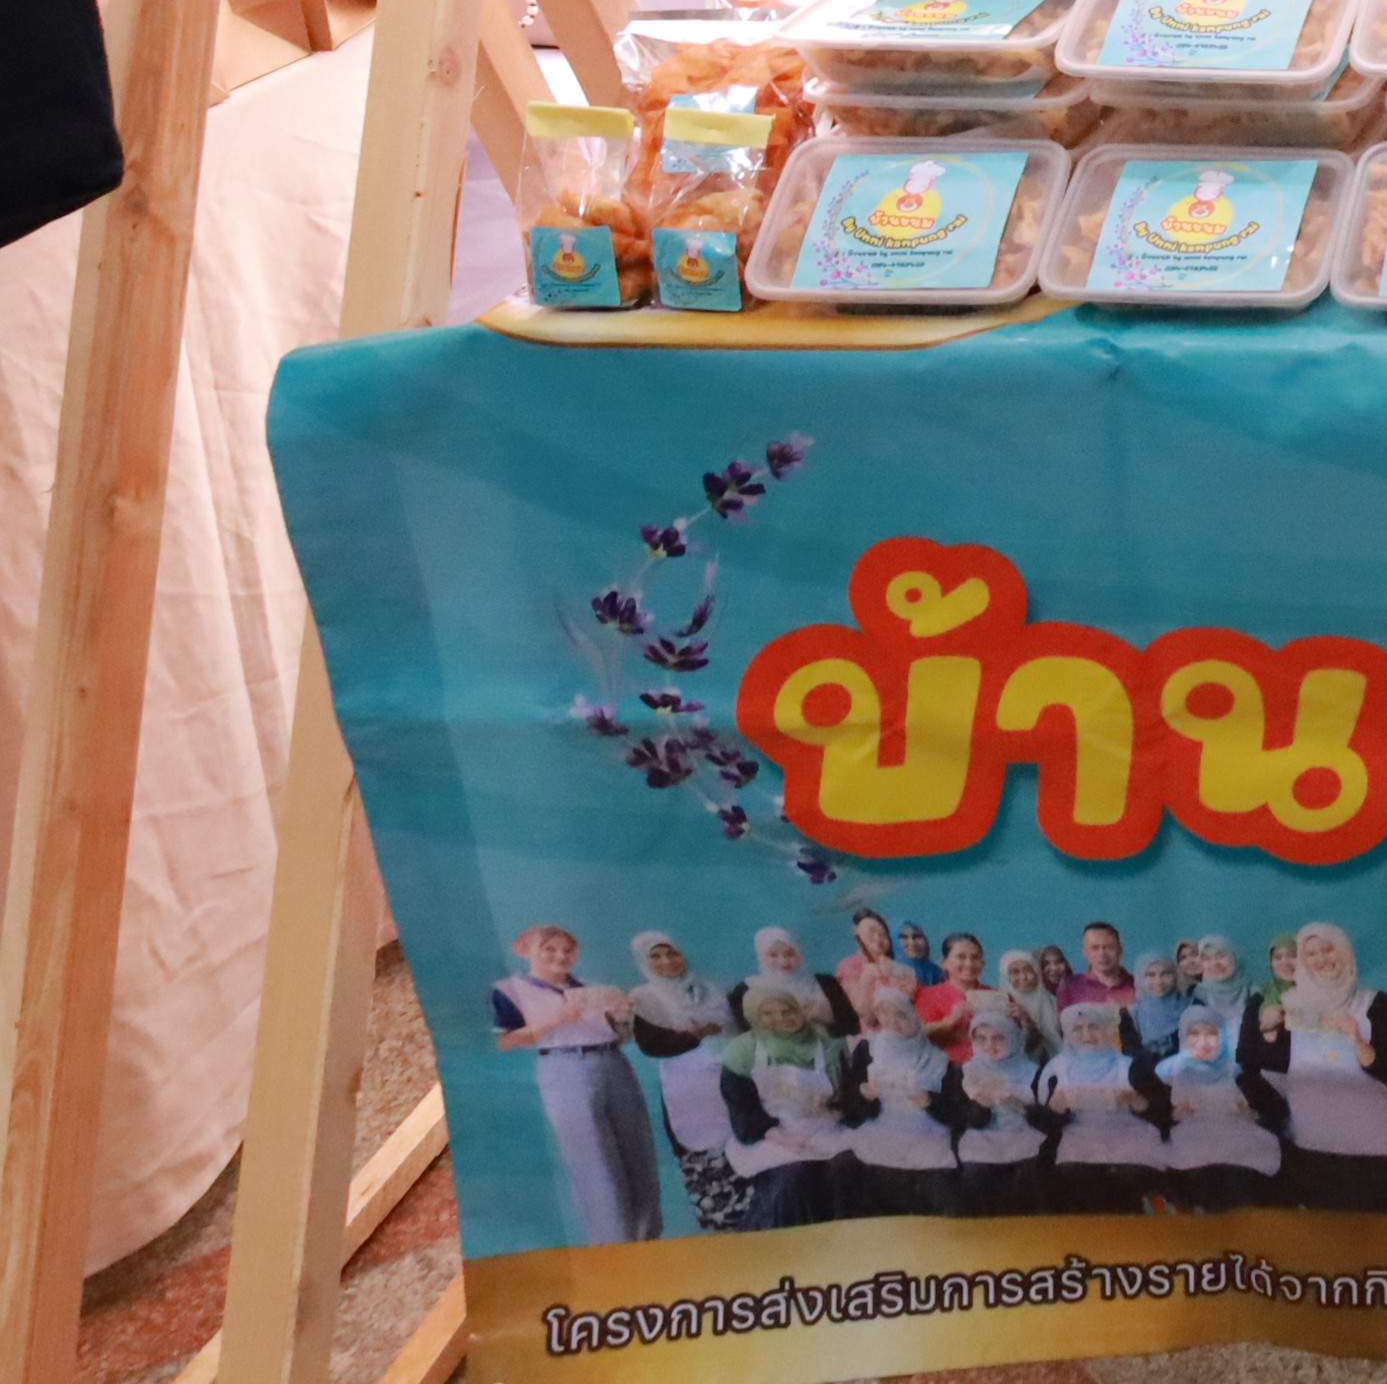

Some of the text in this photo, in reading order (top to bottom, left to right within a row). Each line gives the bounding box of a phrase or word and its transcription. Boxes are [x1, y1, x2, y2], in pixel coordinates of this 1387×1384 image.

[841, 216, 857, 234] By
[868, 210, 935, 229] บ้านขนม
[1160, 216, 1227, 235] บ้านขนม
[1133, 221, 1150, 238] By
